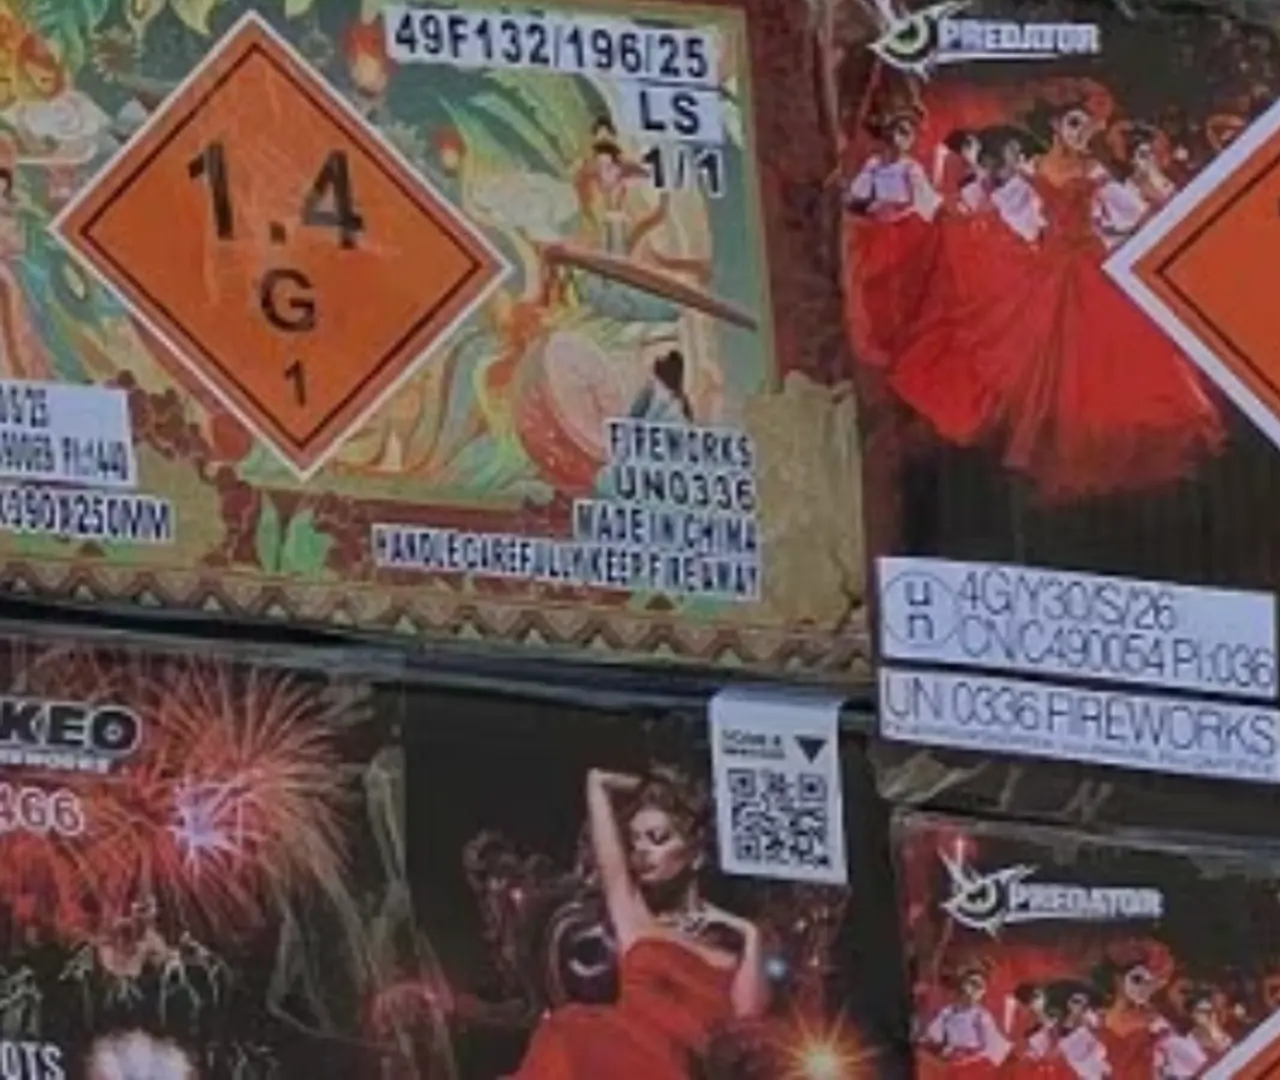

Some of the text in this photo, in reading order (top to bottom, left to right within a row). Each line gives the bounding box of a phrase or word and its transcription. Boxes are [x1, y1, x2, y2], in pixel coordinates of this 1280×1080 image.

[395, 12, 709, 78] 49F132/196/25
[938, 17, 1101, 54] PREDATOR
[640, 90, 700, 135] LS
[642, 147, 723, 195] 1/1
[187, 141, 364, 251] 1.4
[260, 270, 316, 331] G
[284, 362, 305, 407] 1
[885, 675, 943, 719] UN
[952, 680, 1040, 731] 0336
[1048, 691, 1275, 758] FIREWORKS
[1008, 878, 1164, 918] PREDATOR
